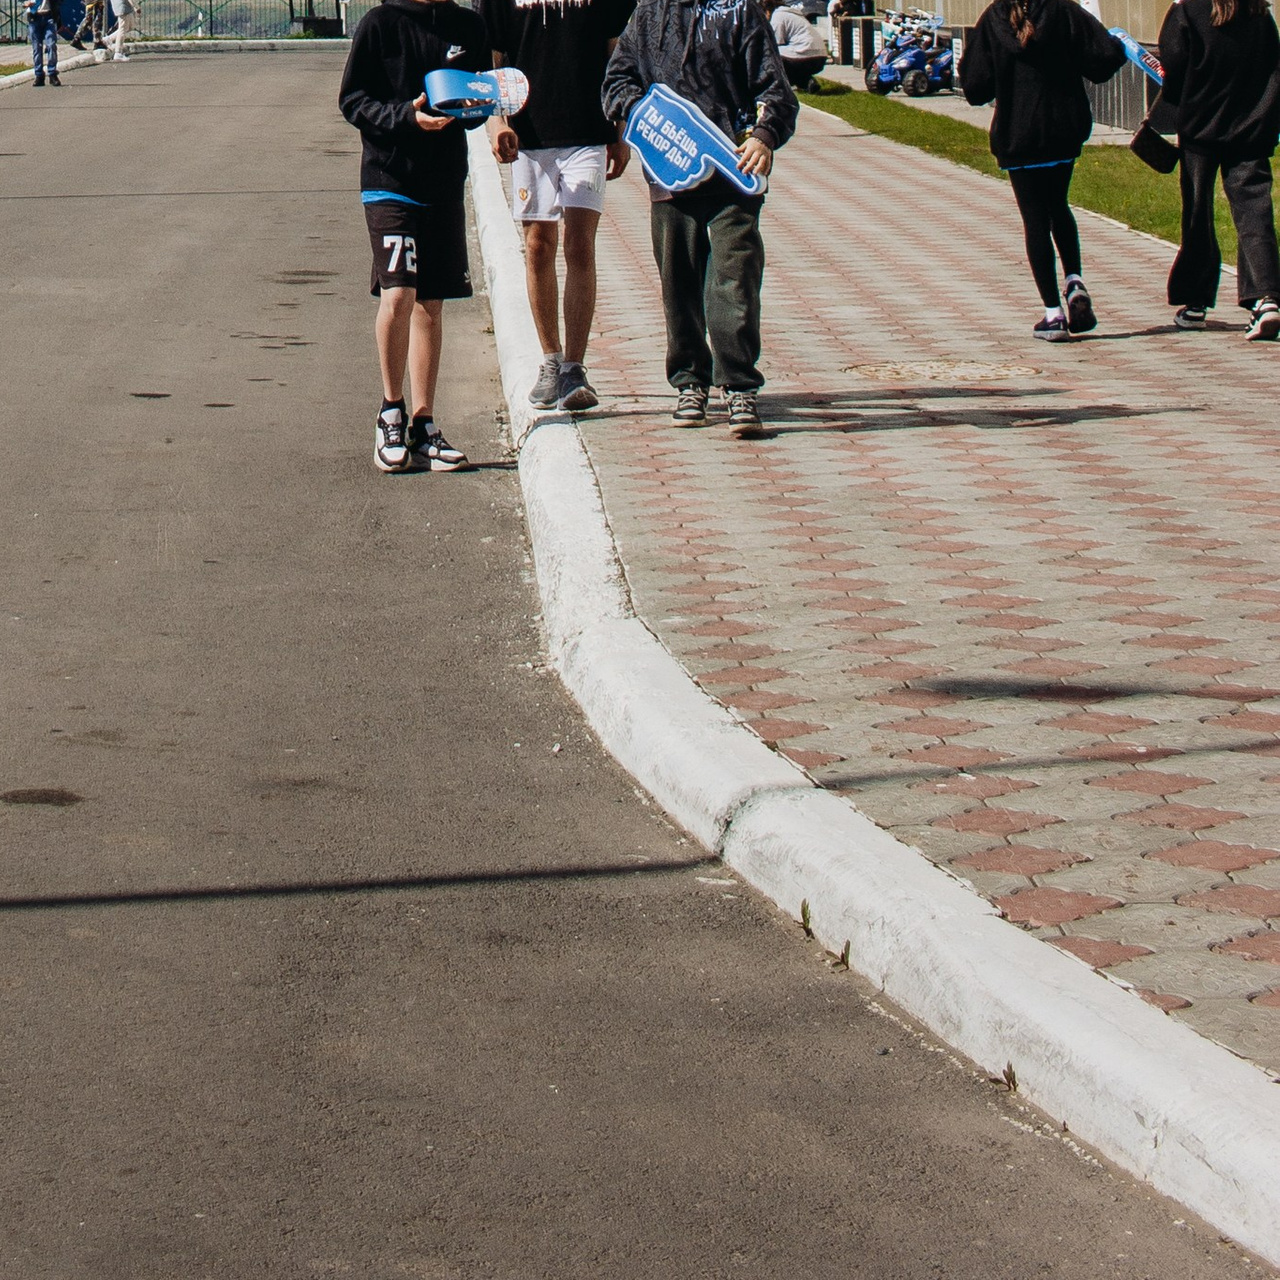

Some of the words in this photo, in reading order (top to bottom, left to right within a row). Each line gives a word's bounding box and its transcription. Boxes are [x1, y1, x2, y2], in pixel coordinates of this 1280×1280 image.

[635, 118, 692, 172] РЕКОРДЫ!
[643, 104, 663, 127] ТЫ
[660, 119, 699, 158] БЬЁШЬ
[383, 234, 418, 273] 72
